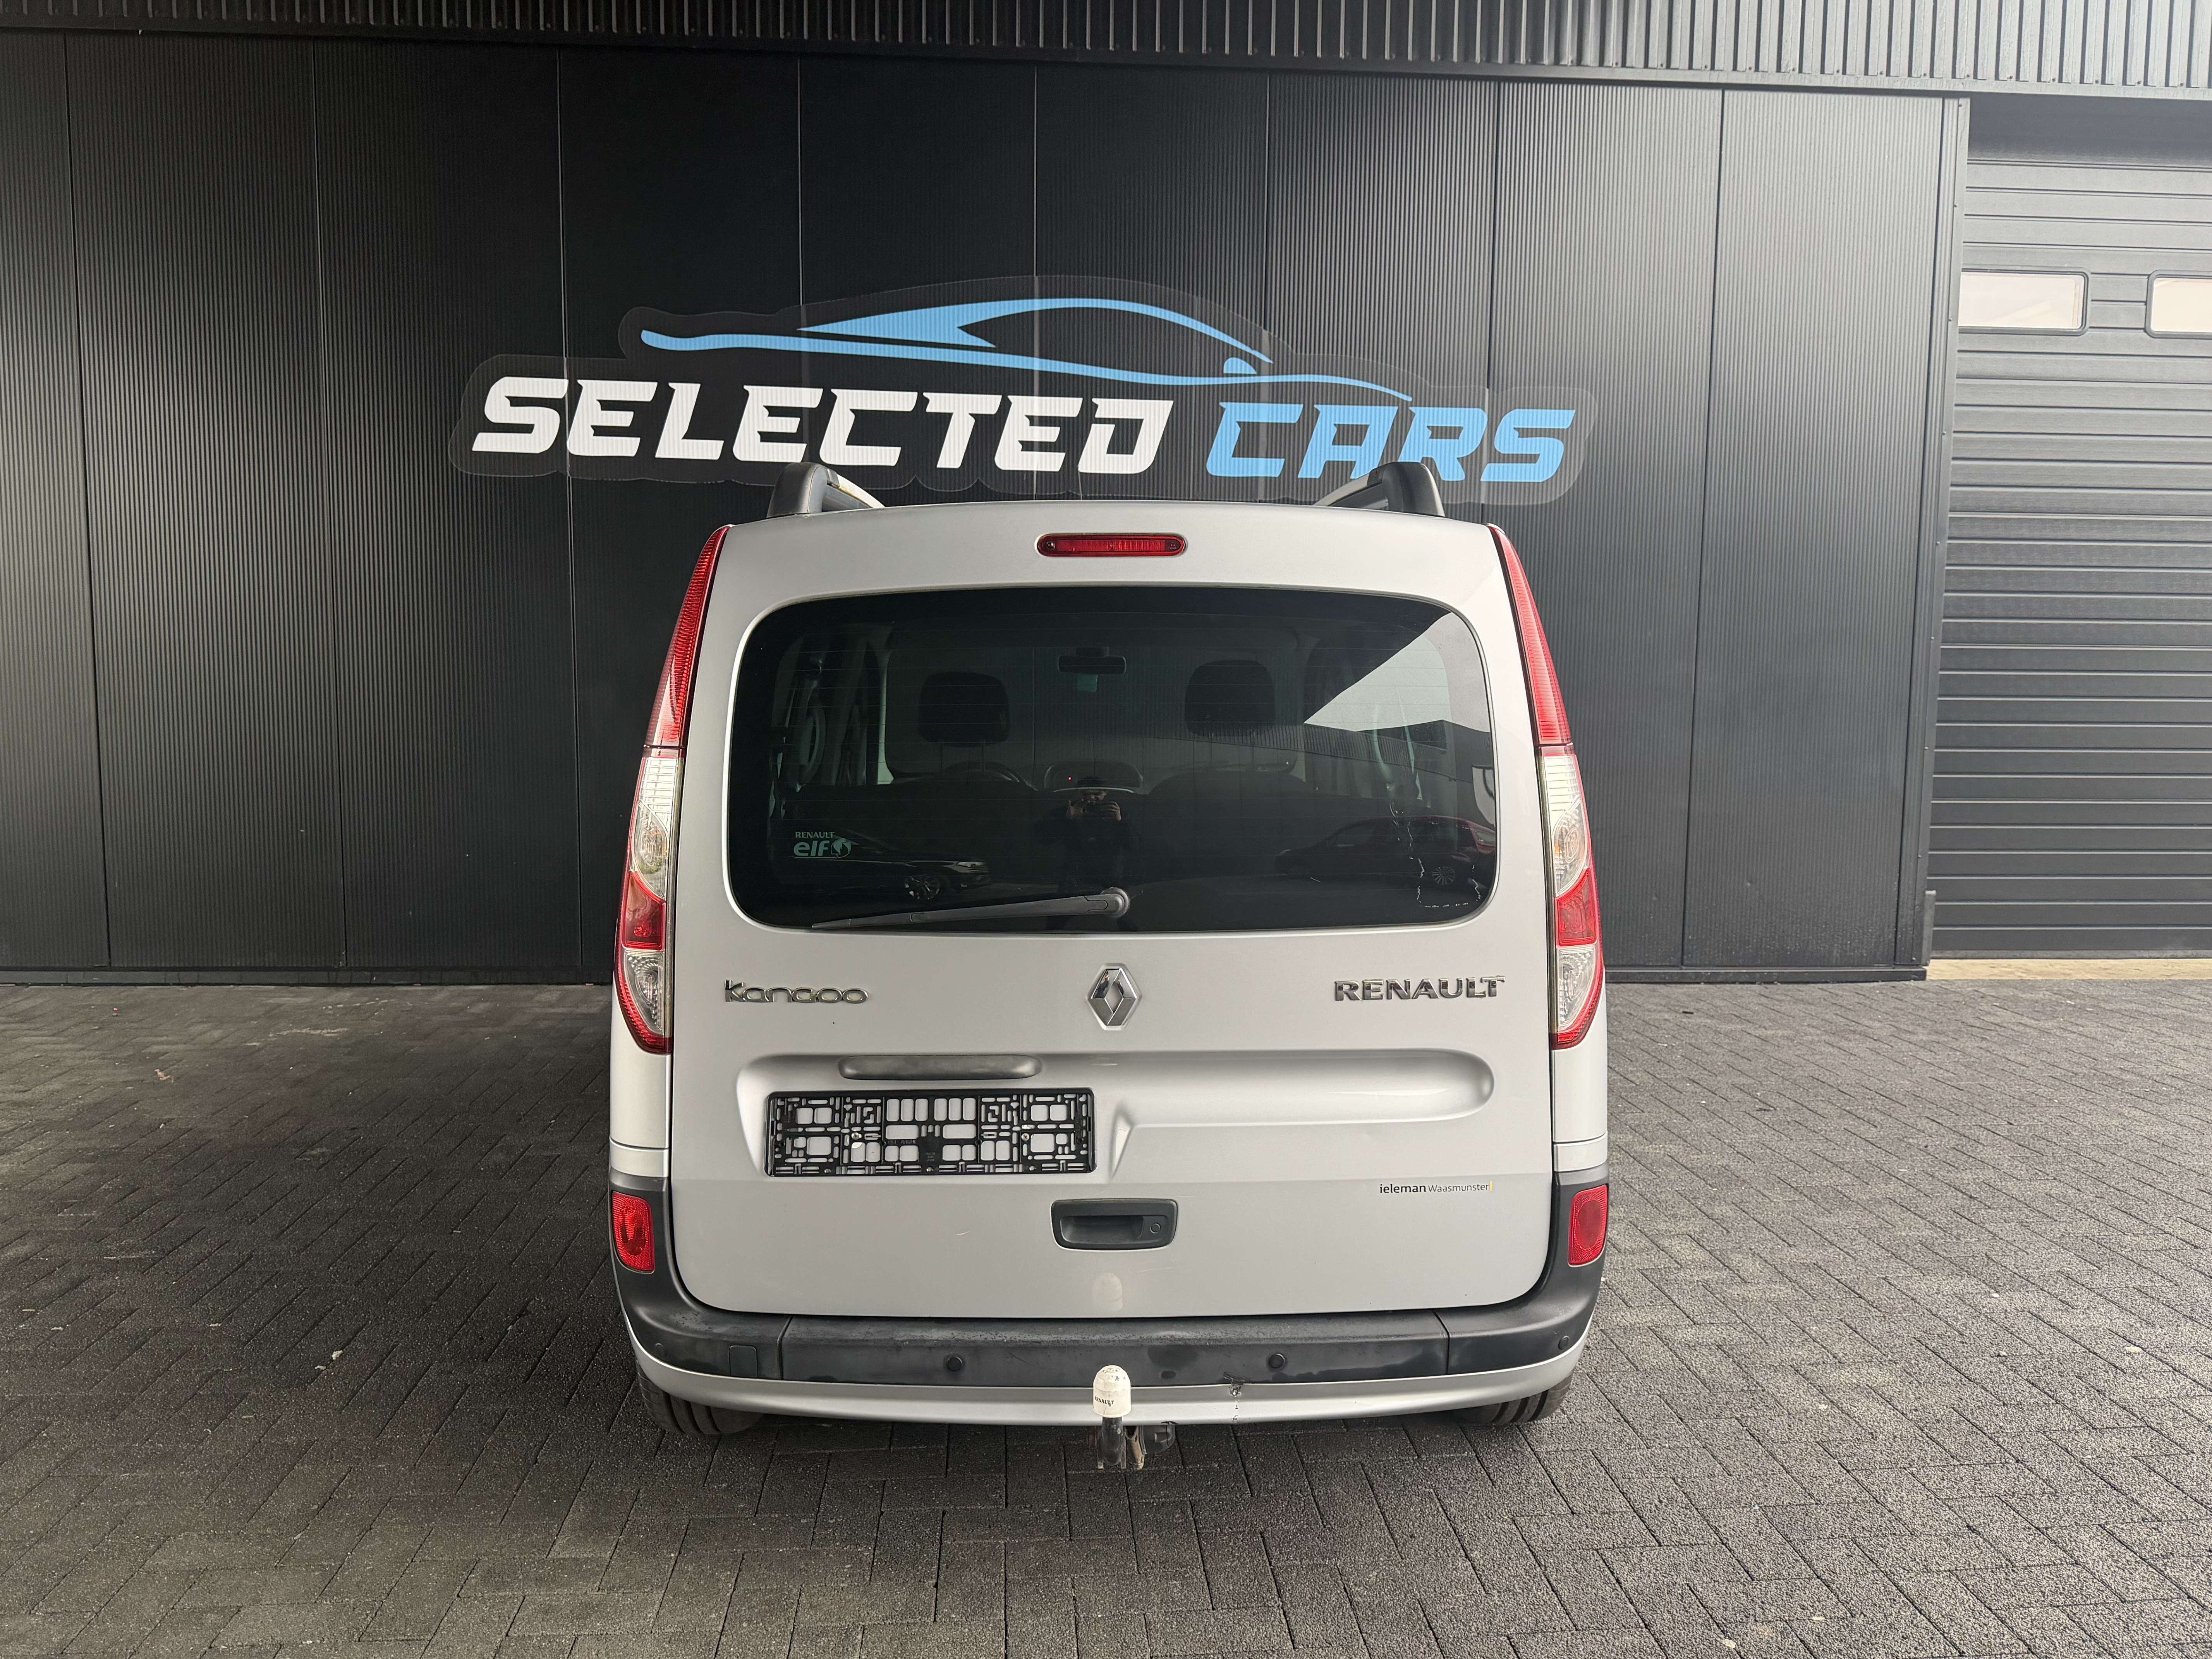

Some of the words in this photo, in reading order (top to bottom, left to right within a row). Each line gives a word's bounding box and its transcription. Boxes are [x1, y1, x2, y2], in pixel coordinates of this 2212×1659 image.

[472, 376, 1173, 474] SELECTED
[1206, 402, 1575, 482] CARS
[793, 840, 830, 856] elf
[1334, 975, 1506, 1001] RENAULT
[1428, 1183, 1489, 1192] Waasmunster
